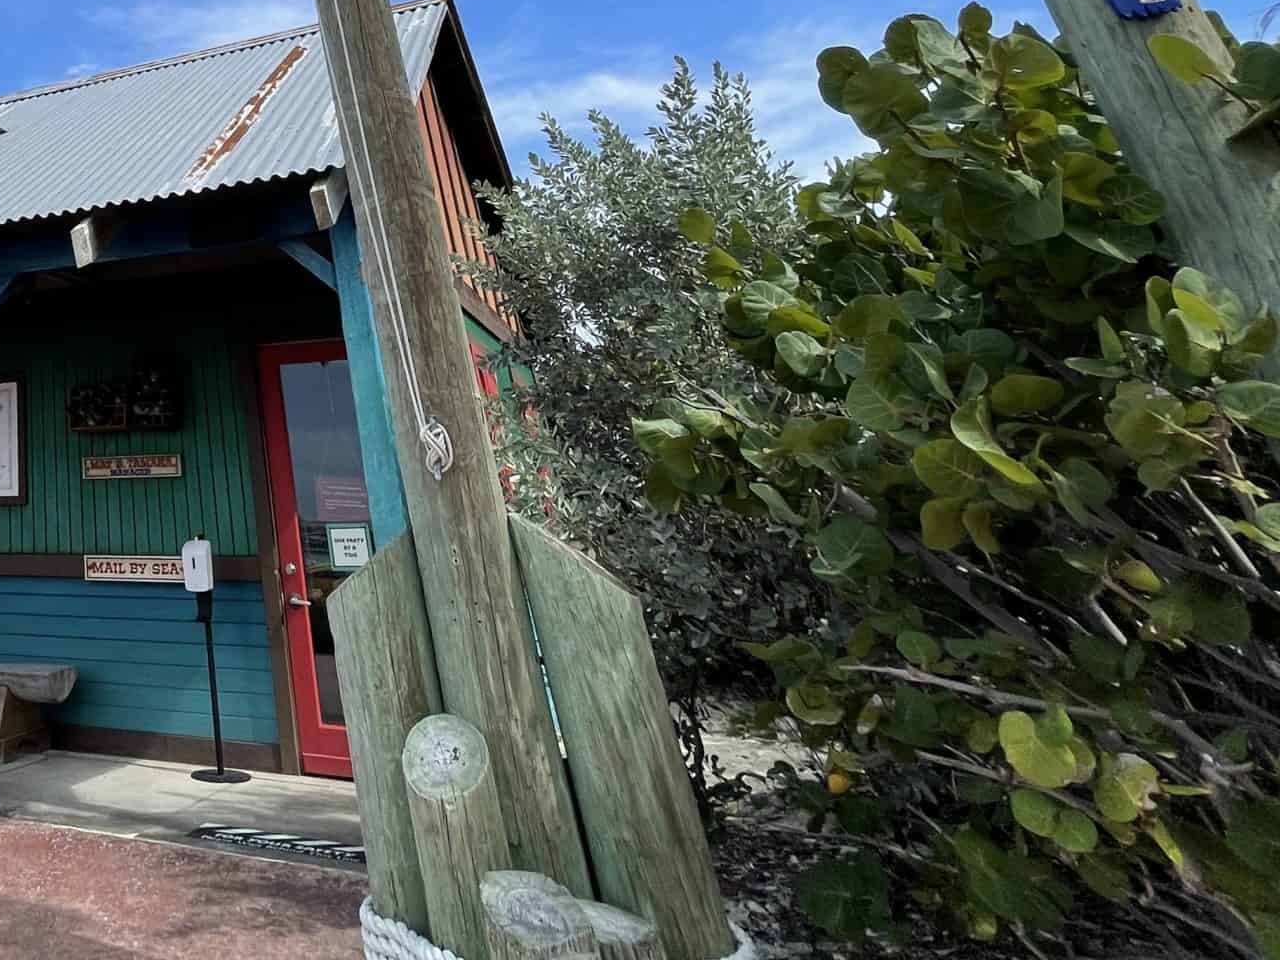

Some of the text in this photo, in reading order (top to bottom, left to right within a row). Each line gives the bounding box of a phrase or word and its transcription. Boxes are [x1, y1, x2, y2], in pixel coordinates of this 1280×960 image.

[92, 562, 180, 576] MAIL BY SEA
